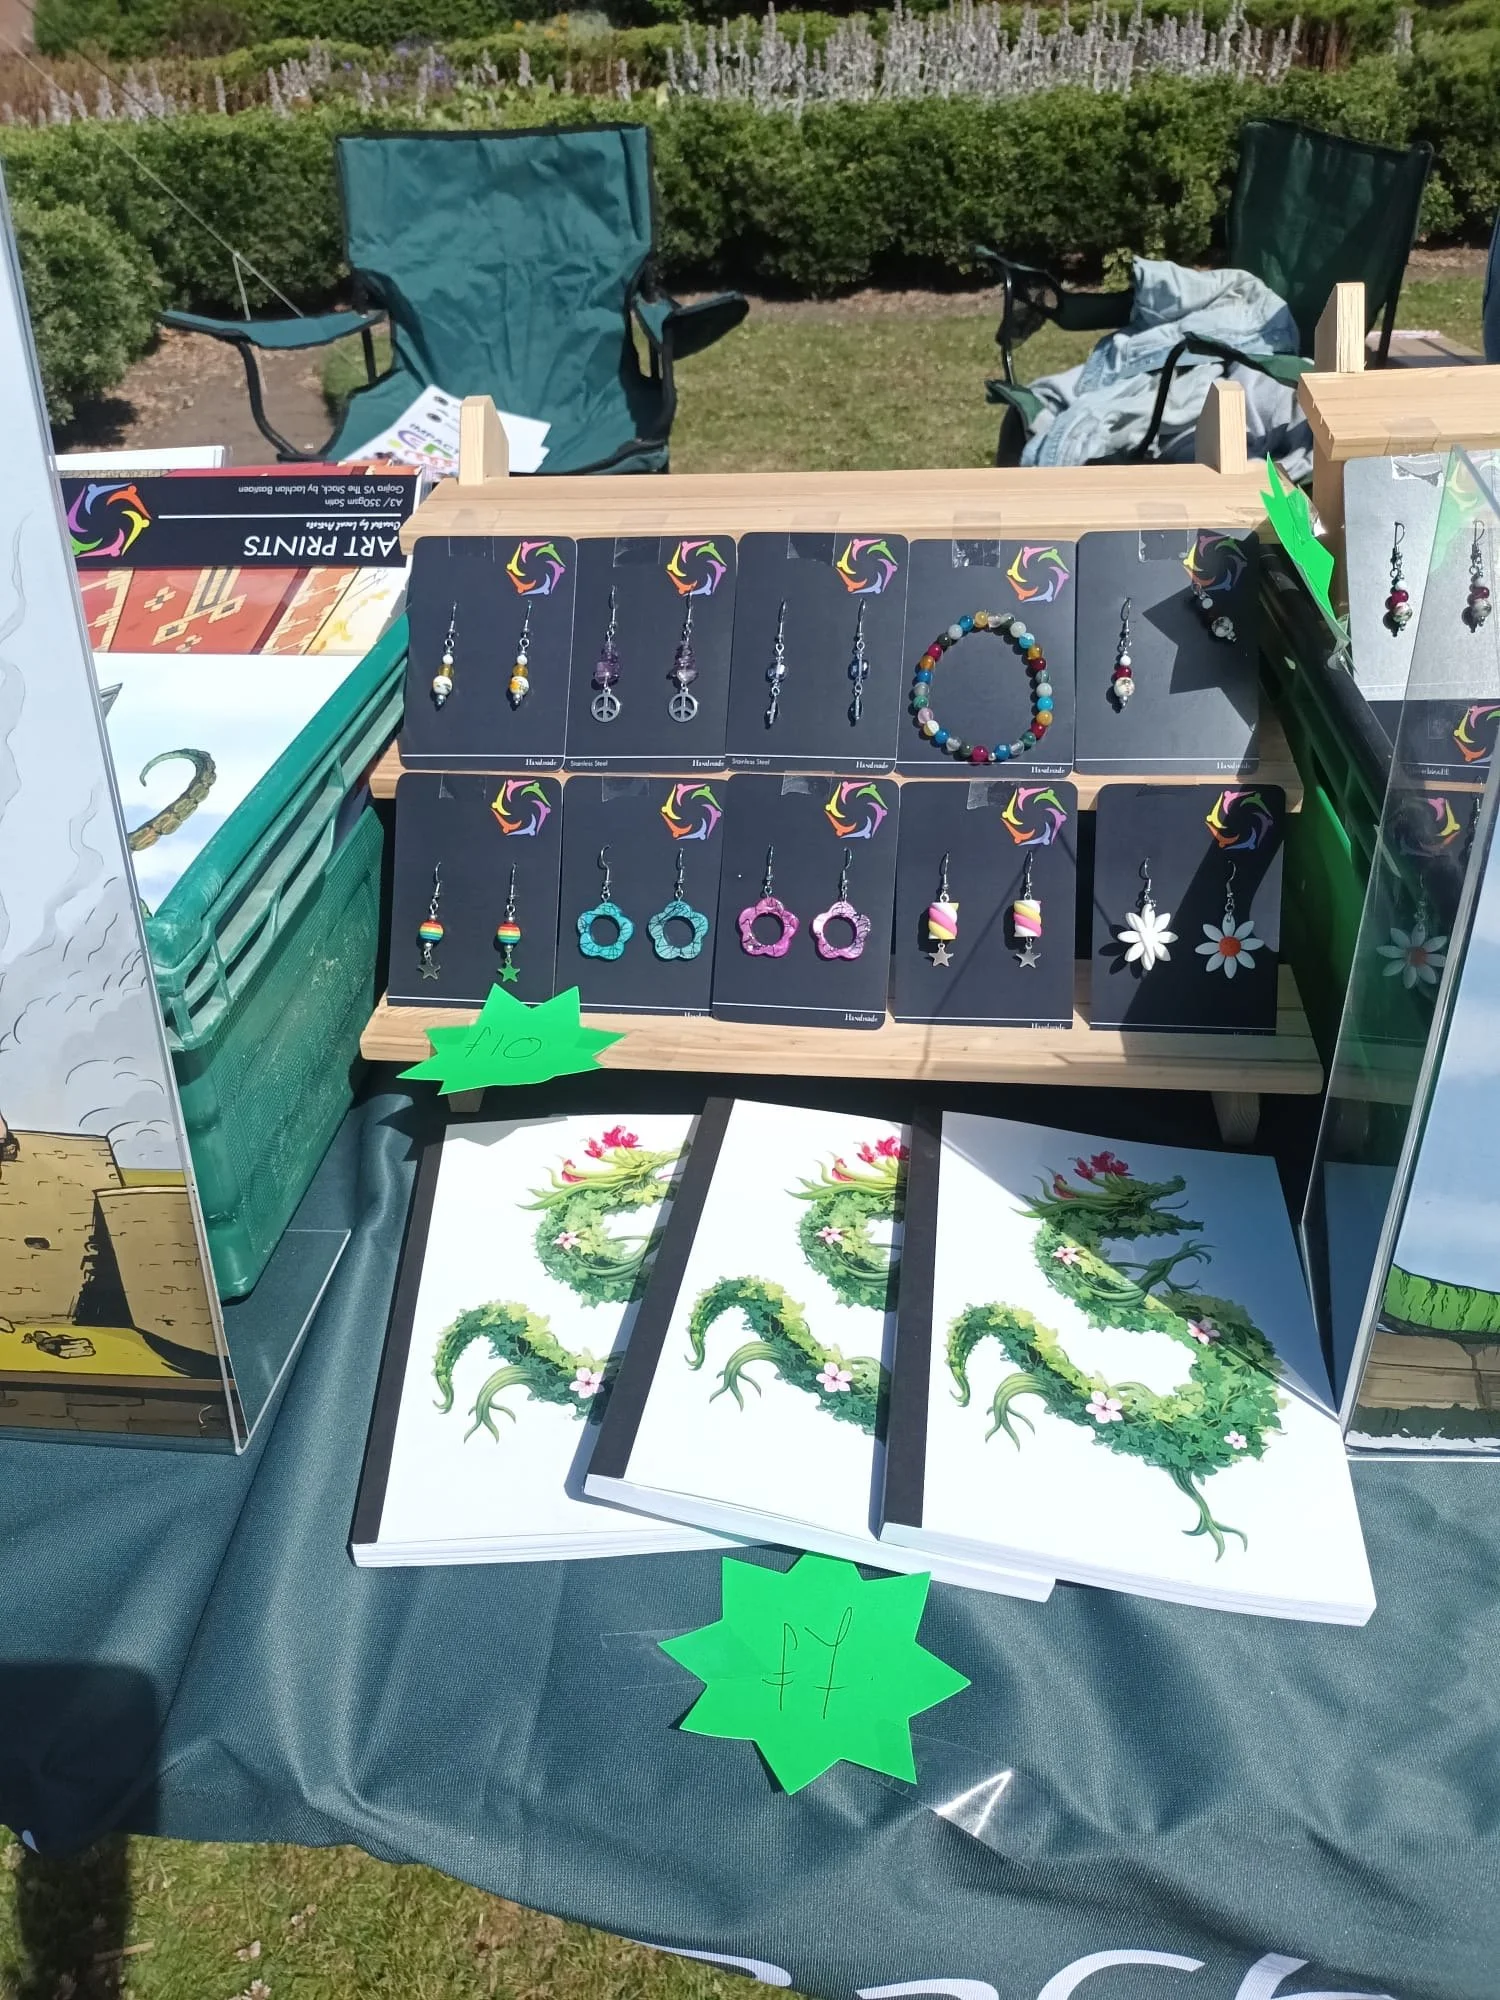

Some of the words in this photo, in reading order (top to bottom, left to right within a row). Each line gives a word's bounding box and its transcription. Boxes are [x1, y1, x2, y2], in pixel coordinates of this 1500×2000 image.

[409, 423, 459, 455] IMPAC
[275, 485, 306, 495] Lachlan
[307, 484, 319, 495] by
[347, 485, 362, 494] The
[363, 485, 376, 494] VS
[376, 483, 405, 494] Gojira
[325, 498, 345, 508] Satin
[347, 497, 382, 508] 350gsm
[383, 497, 403, 508] A3/
[306, 521, 335, 531] Artists
[335, 521, 358, 531] Local
[359, 519, 370, 531] by
[371, 521, 401, 531] Created
[243, 535, 338, 556] PRINTS
[343, 535, 399, 557] ART
[525, 758, 557, 767] Handmade
[570, 759, 594, 768] Stainless
[692, 759, 725, 768] Handmade
[731, 757, 755, 766] Stainless
[756, 758, 770, 767] Steel
[856, 761, 890, 770] Handmade
[1031, 765, 1066, 775] Handmade
[844, 1013, 878, 1023] Handmade
[465, 1026, 542, 1059] £10
